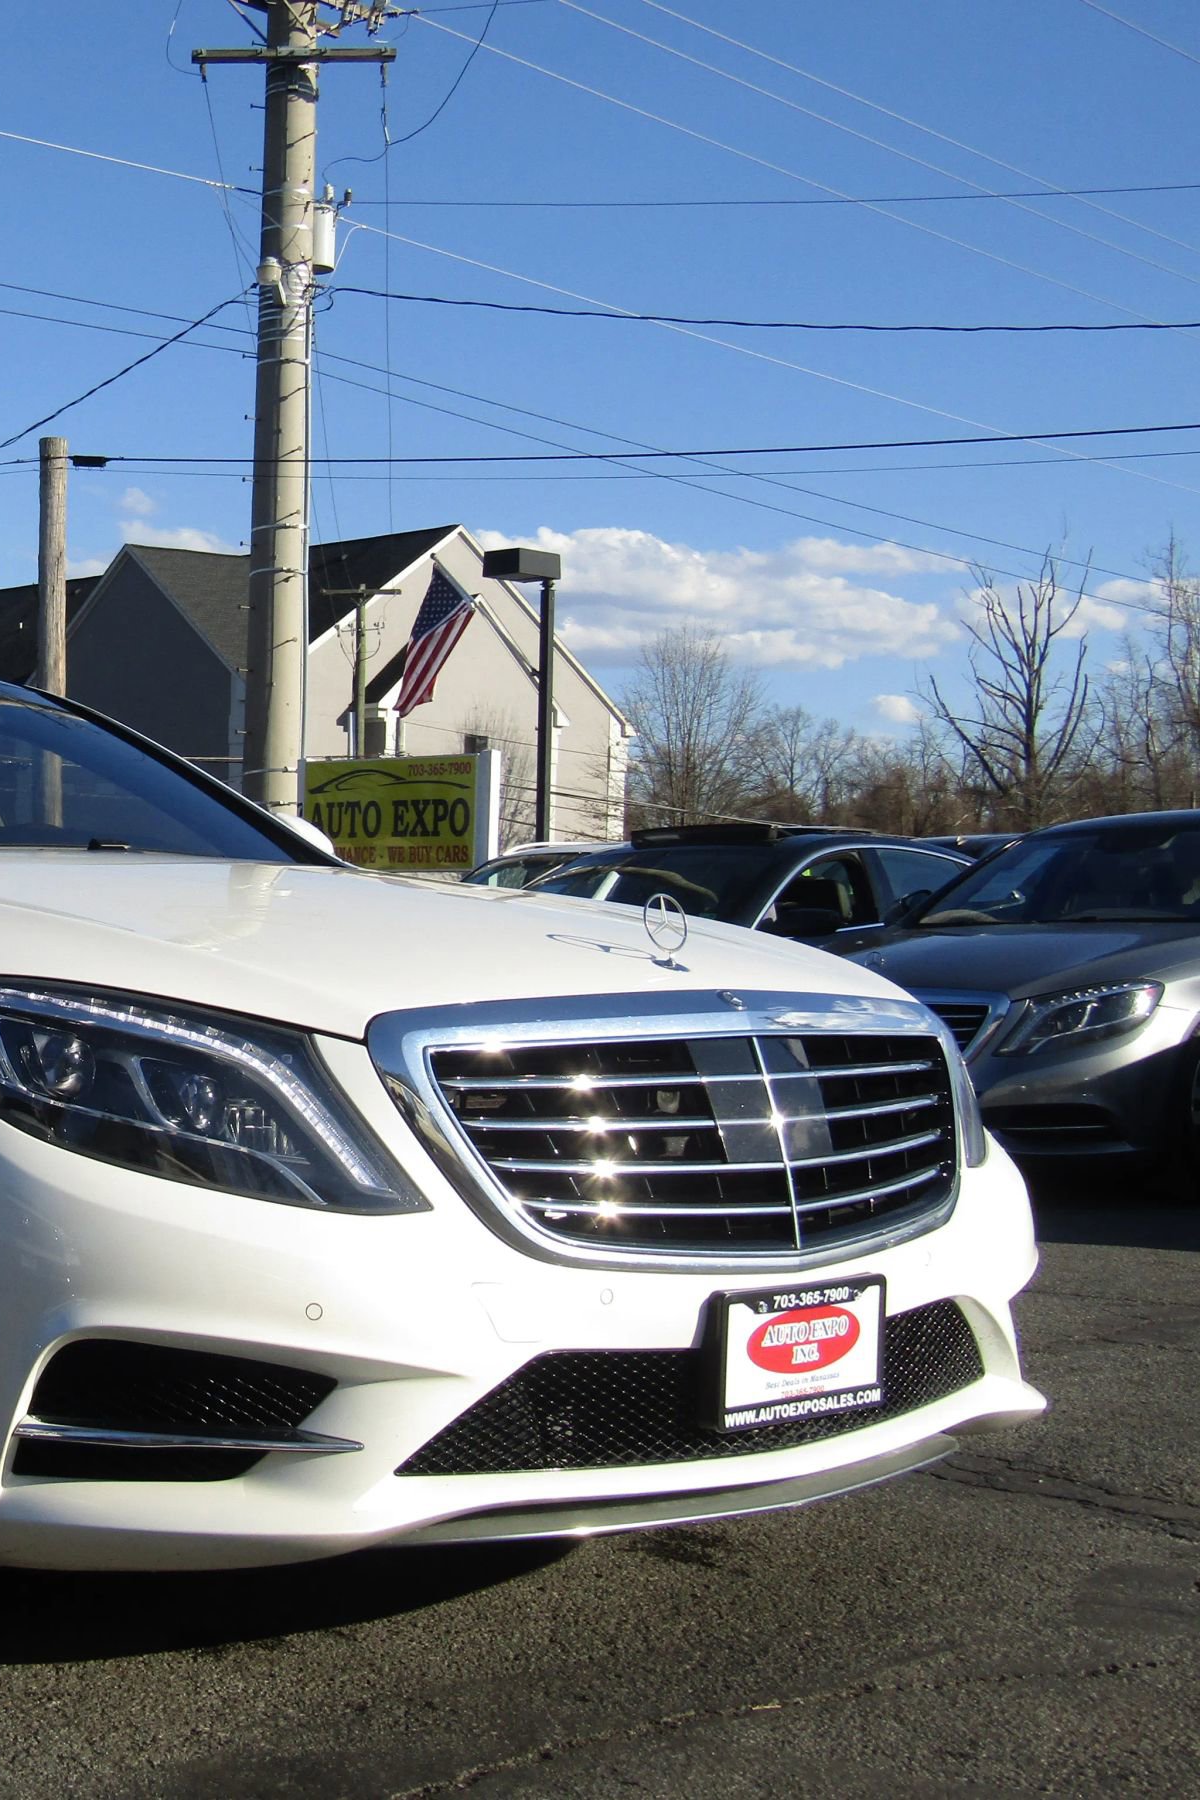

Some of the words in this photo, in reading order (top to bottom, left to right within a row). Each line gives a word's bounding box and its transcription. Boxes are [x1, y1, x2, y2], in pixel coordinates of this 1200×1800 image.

[408, 762, 471, 776] 703-365-7900
[311, 800, 382, 839] AUTO
[391, 797, 470, 838] EXPO
[387, 847, 405, 863] WE
[408, 846, 433, 863] BUY
[435, 845, 469, 863] CARS
[773, 1287, 849, 1309] 703-365-7900
[762, 1323, 808, 1346] AUTO
[811, 1316, 848, 1339] EXPO
[793, 1345, 818, 1362] INC.
[782, 1378, 800, 1387] Deals
[724, 1388, 881, 1427] WWW.AUTOEXPOSALES.COM
